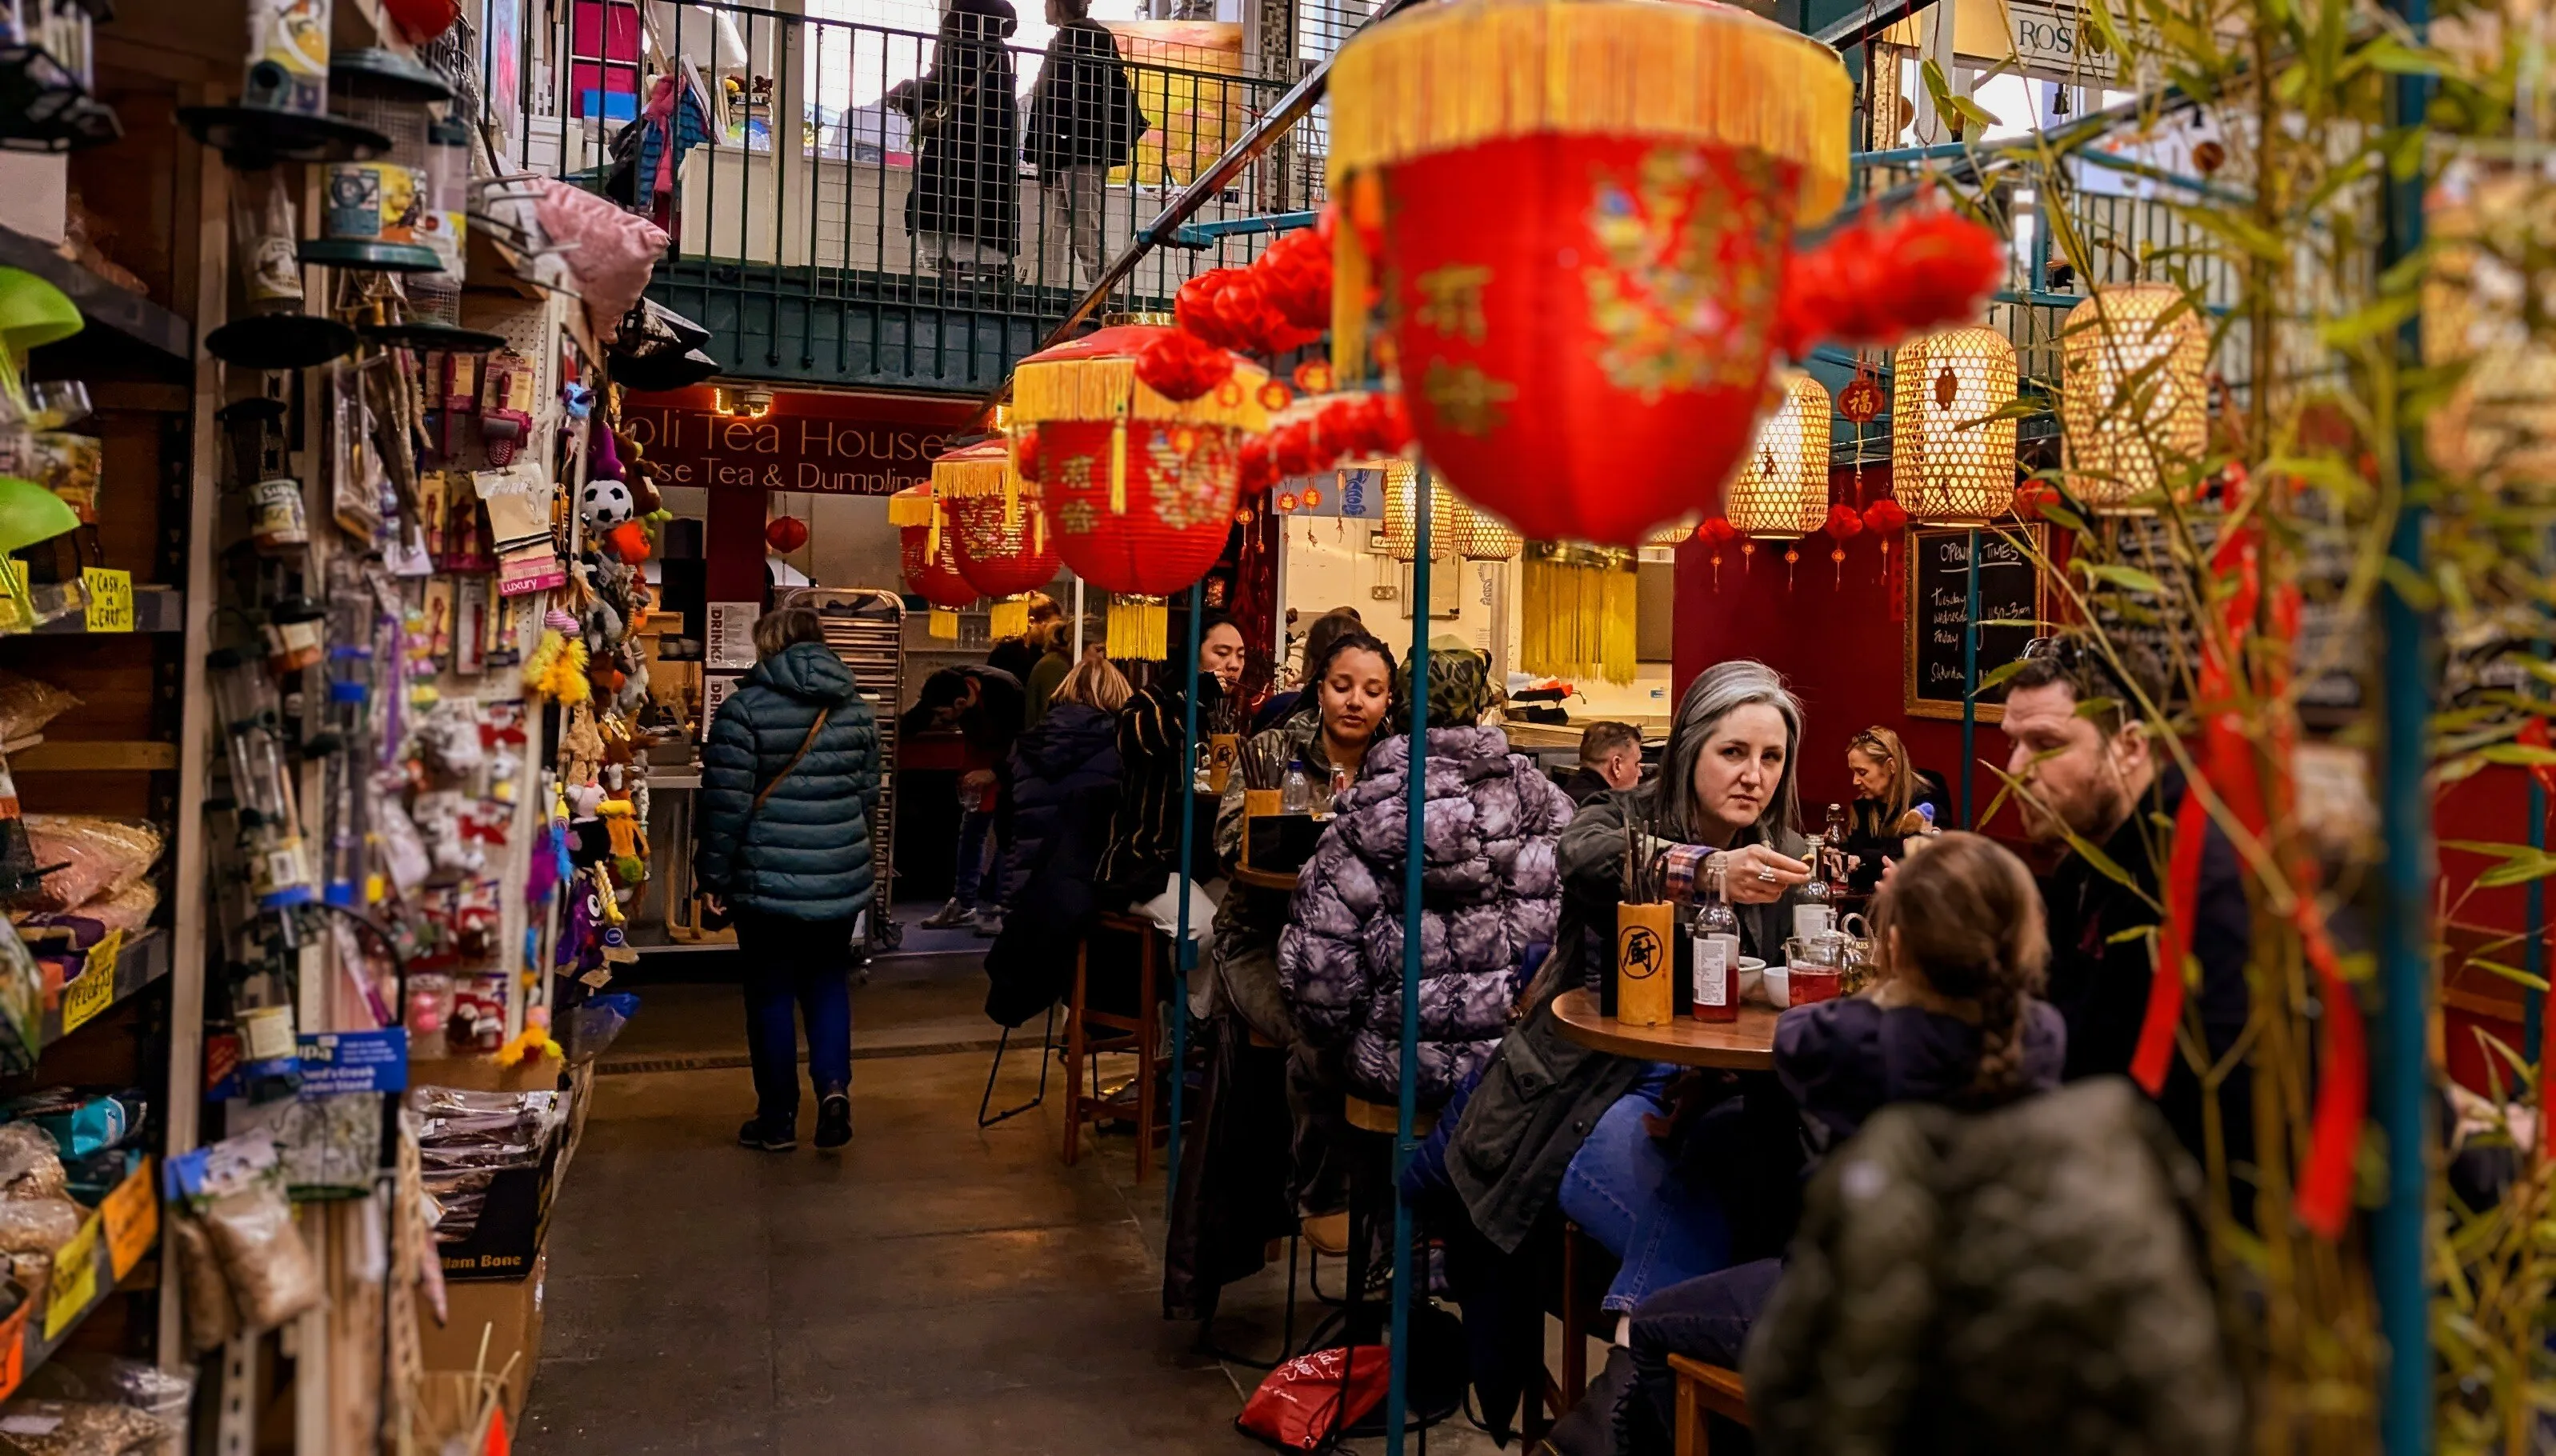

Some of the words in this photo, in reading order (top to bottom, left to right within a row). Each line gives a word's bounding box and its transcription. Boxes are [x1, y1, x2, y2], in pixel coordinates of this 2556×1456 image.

[624, 410, 680, 448] oli
[694, 413, 779, 454] Tea
[801, 420, 945, 462] House
[654, 462, 692, 482] se
[700, 457, 754, 486] Tea
[763, 463, 785, 487] &
[798, 462, 930, 495] Dumplin
[501, 578, 537, 593] Luxury
[481, 1254, 522, 1267] Bone
